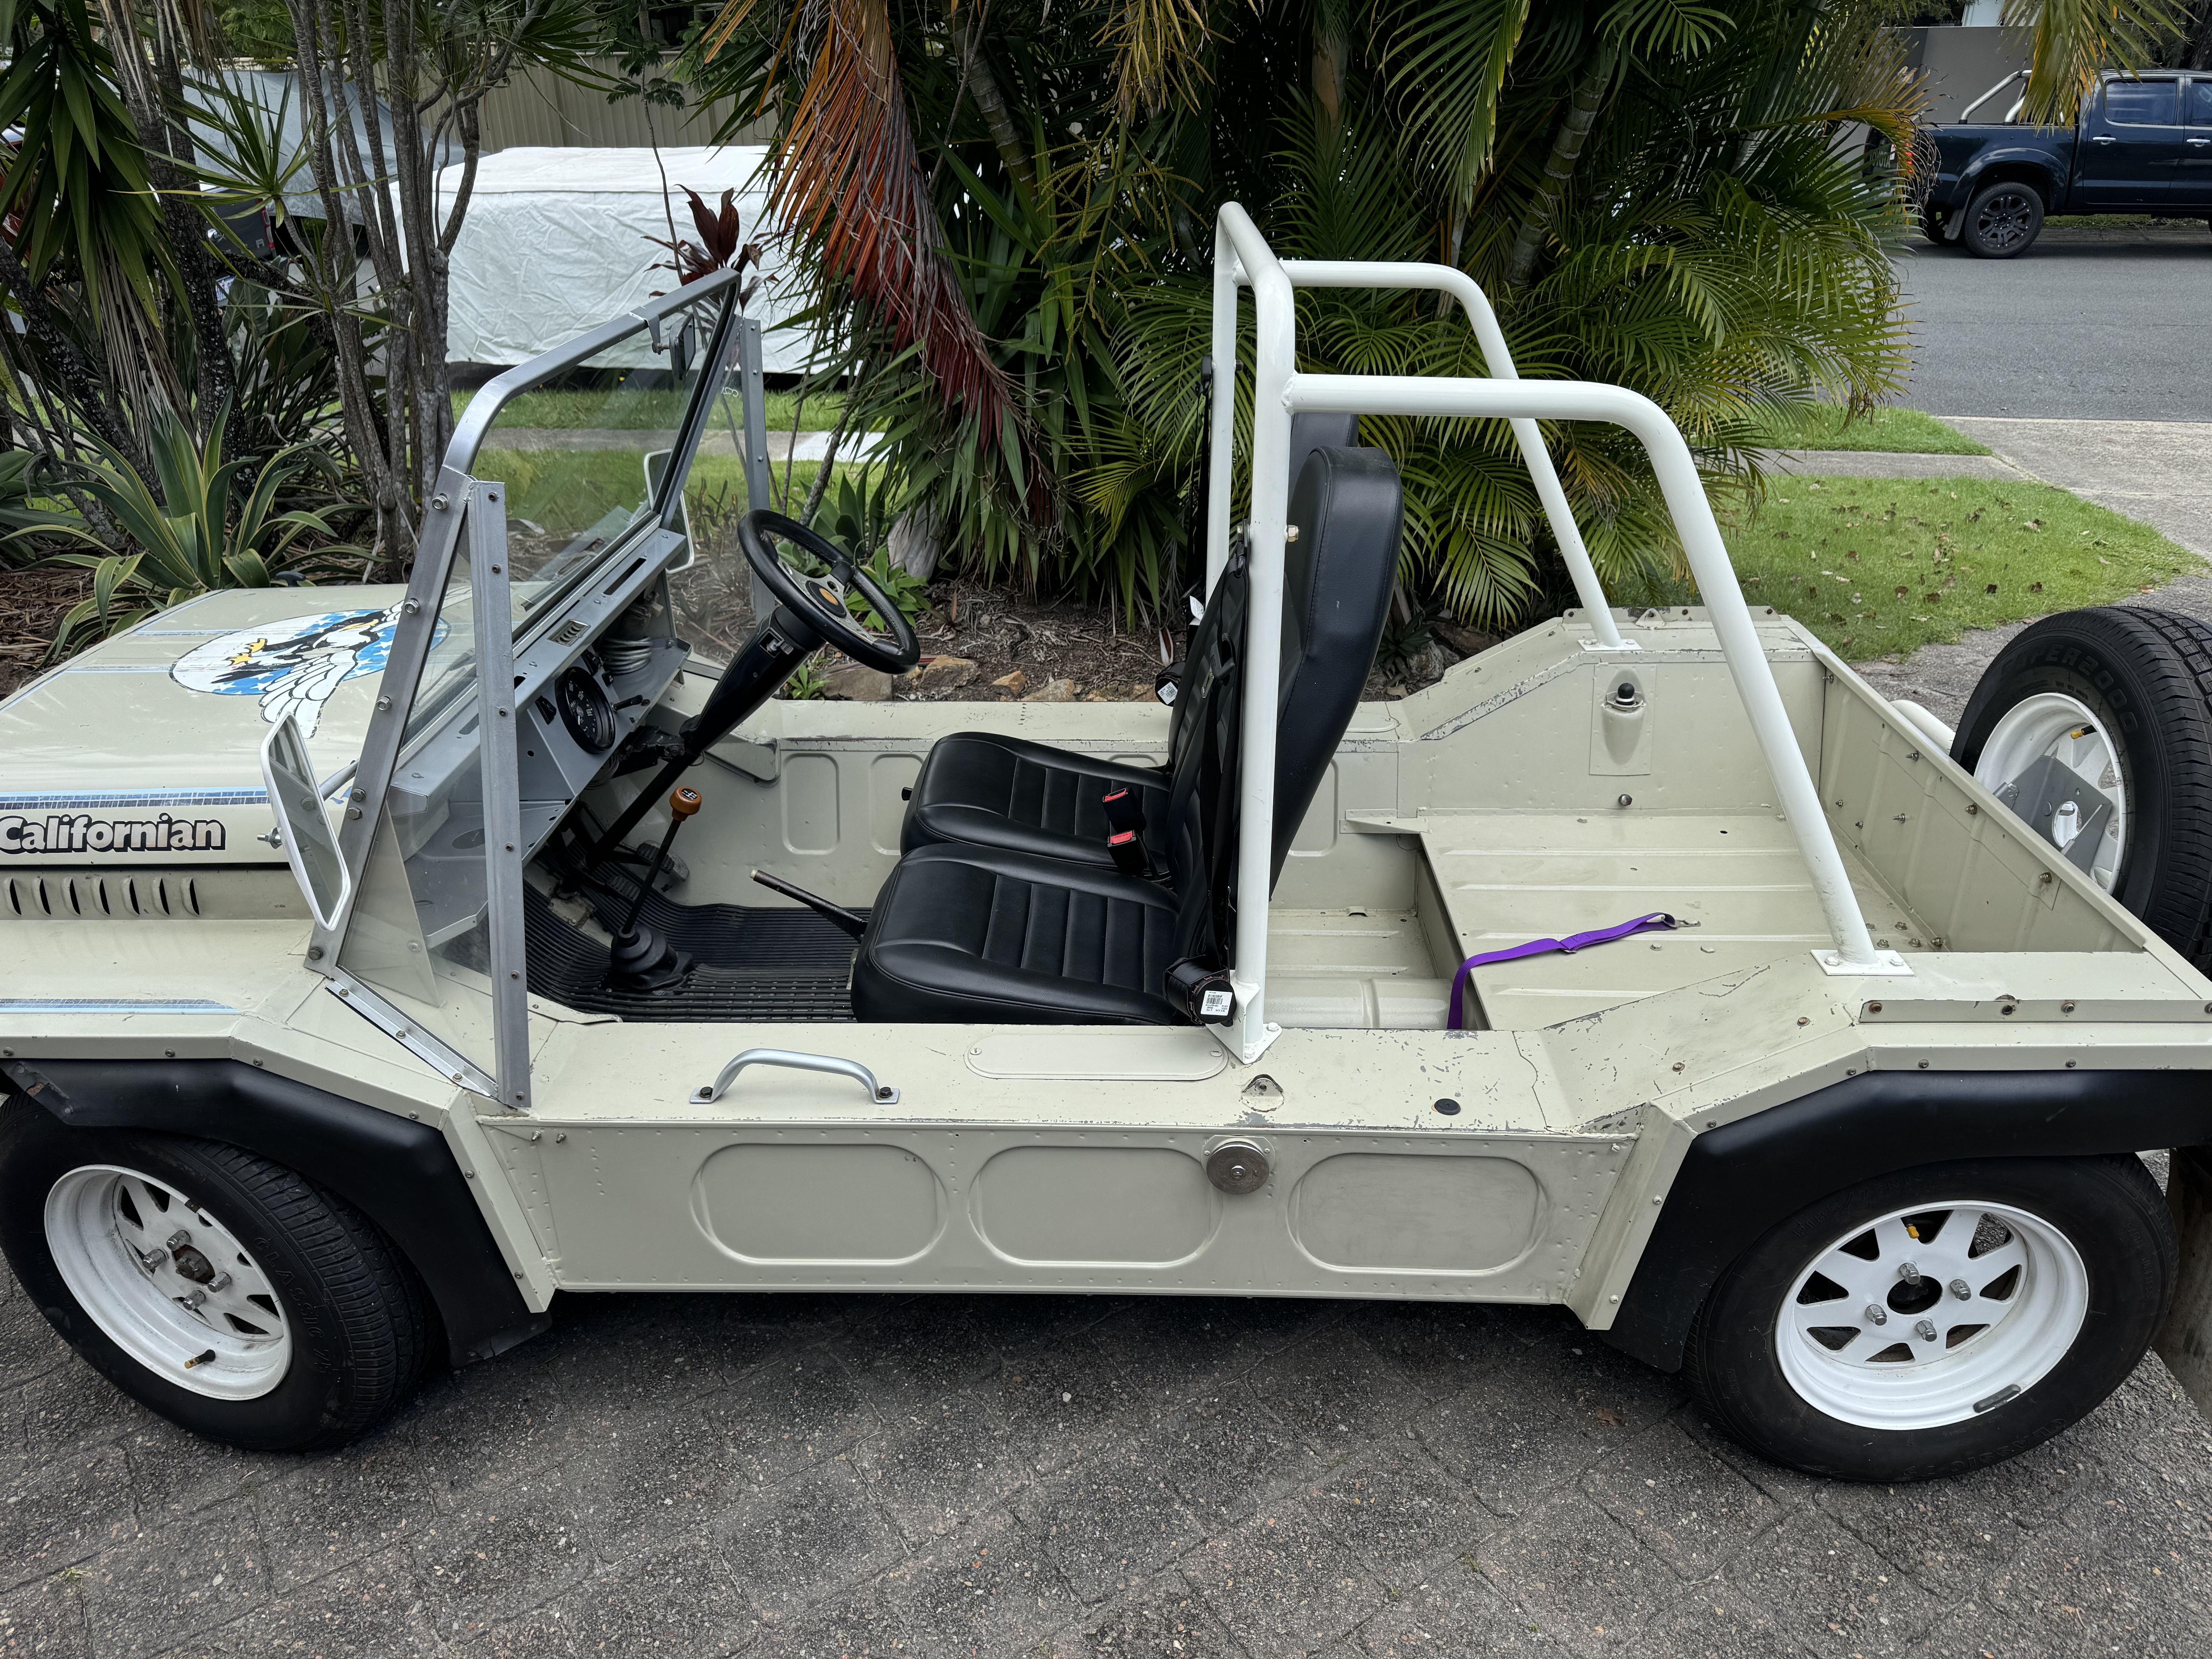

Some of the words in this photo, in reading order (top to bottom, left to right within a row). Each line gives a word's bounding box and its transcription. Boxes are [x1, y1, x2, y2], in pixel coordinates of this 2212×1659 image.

[0, 814, 226, 854] Californian
[254, 1237, 324, 1338] CLASSIC
[313, 1348, 331, 1374] 75
[1949, 1418, 2067, 1473] CLASSIC
